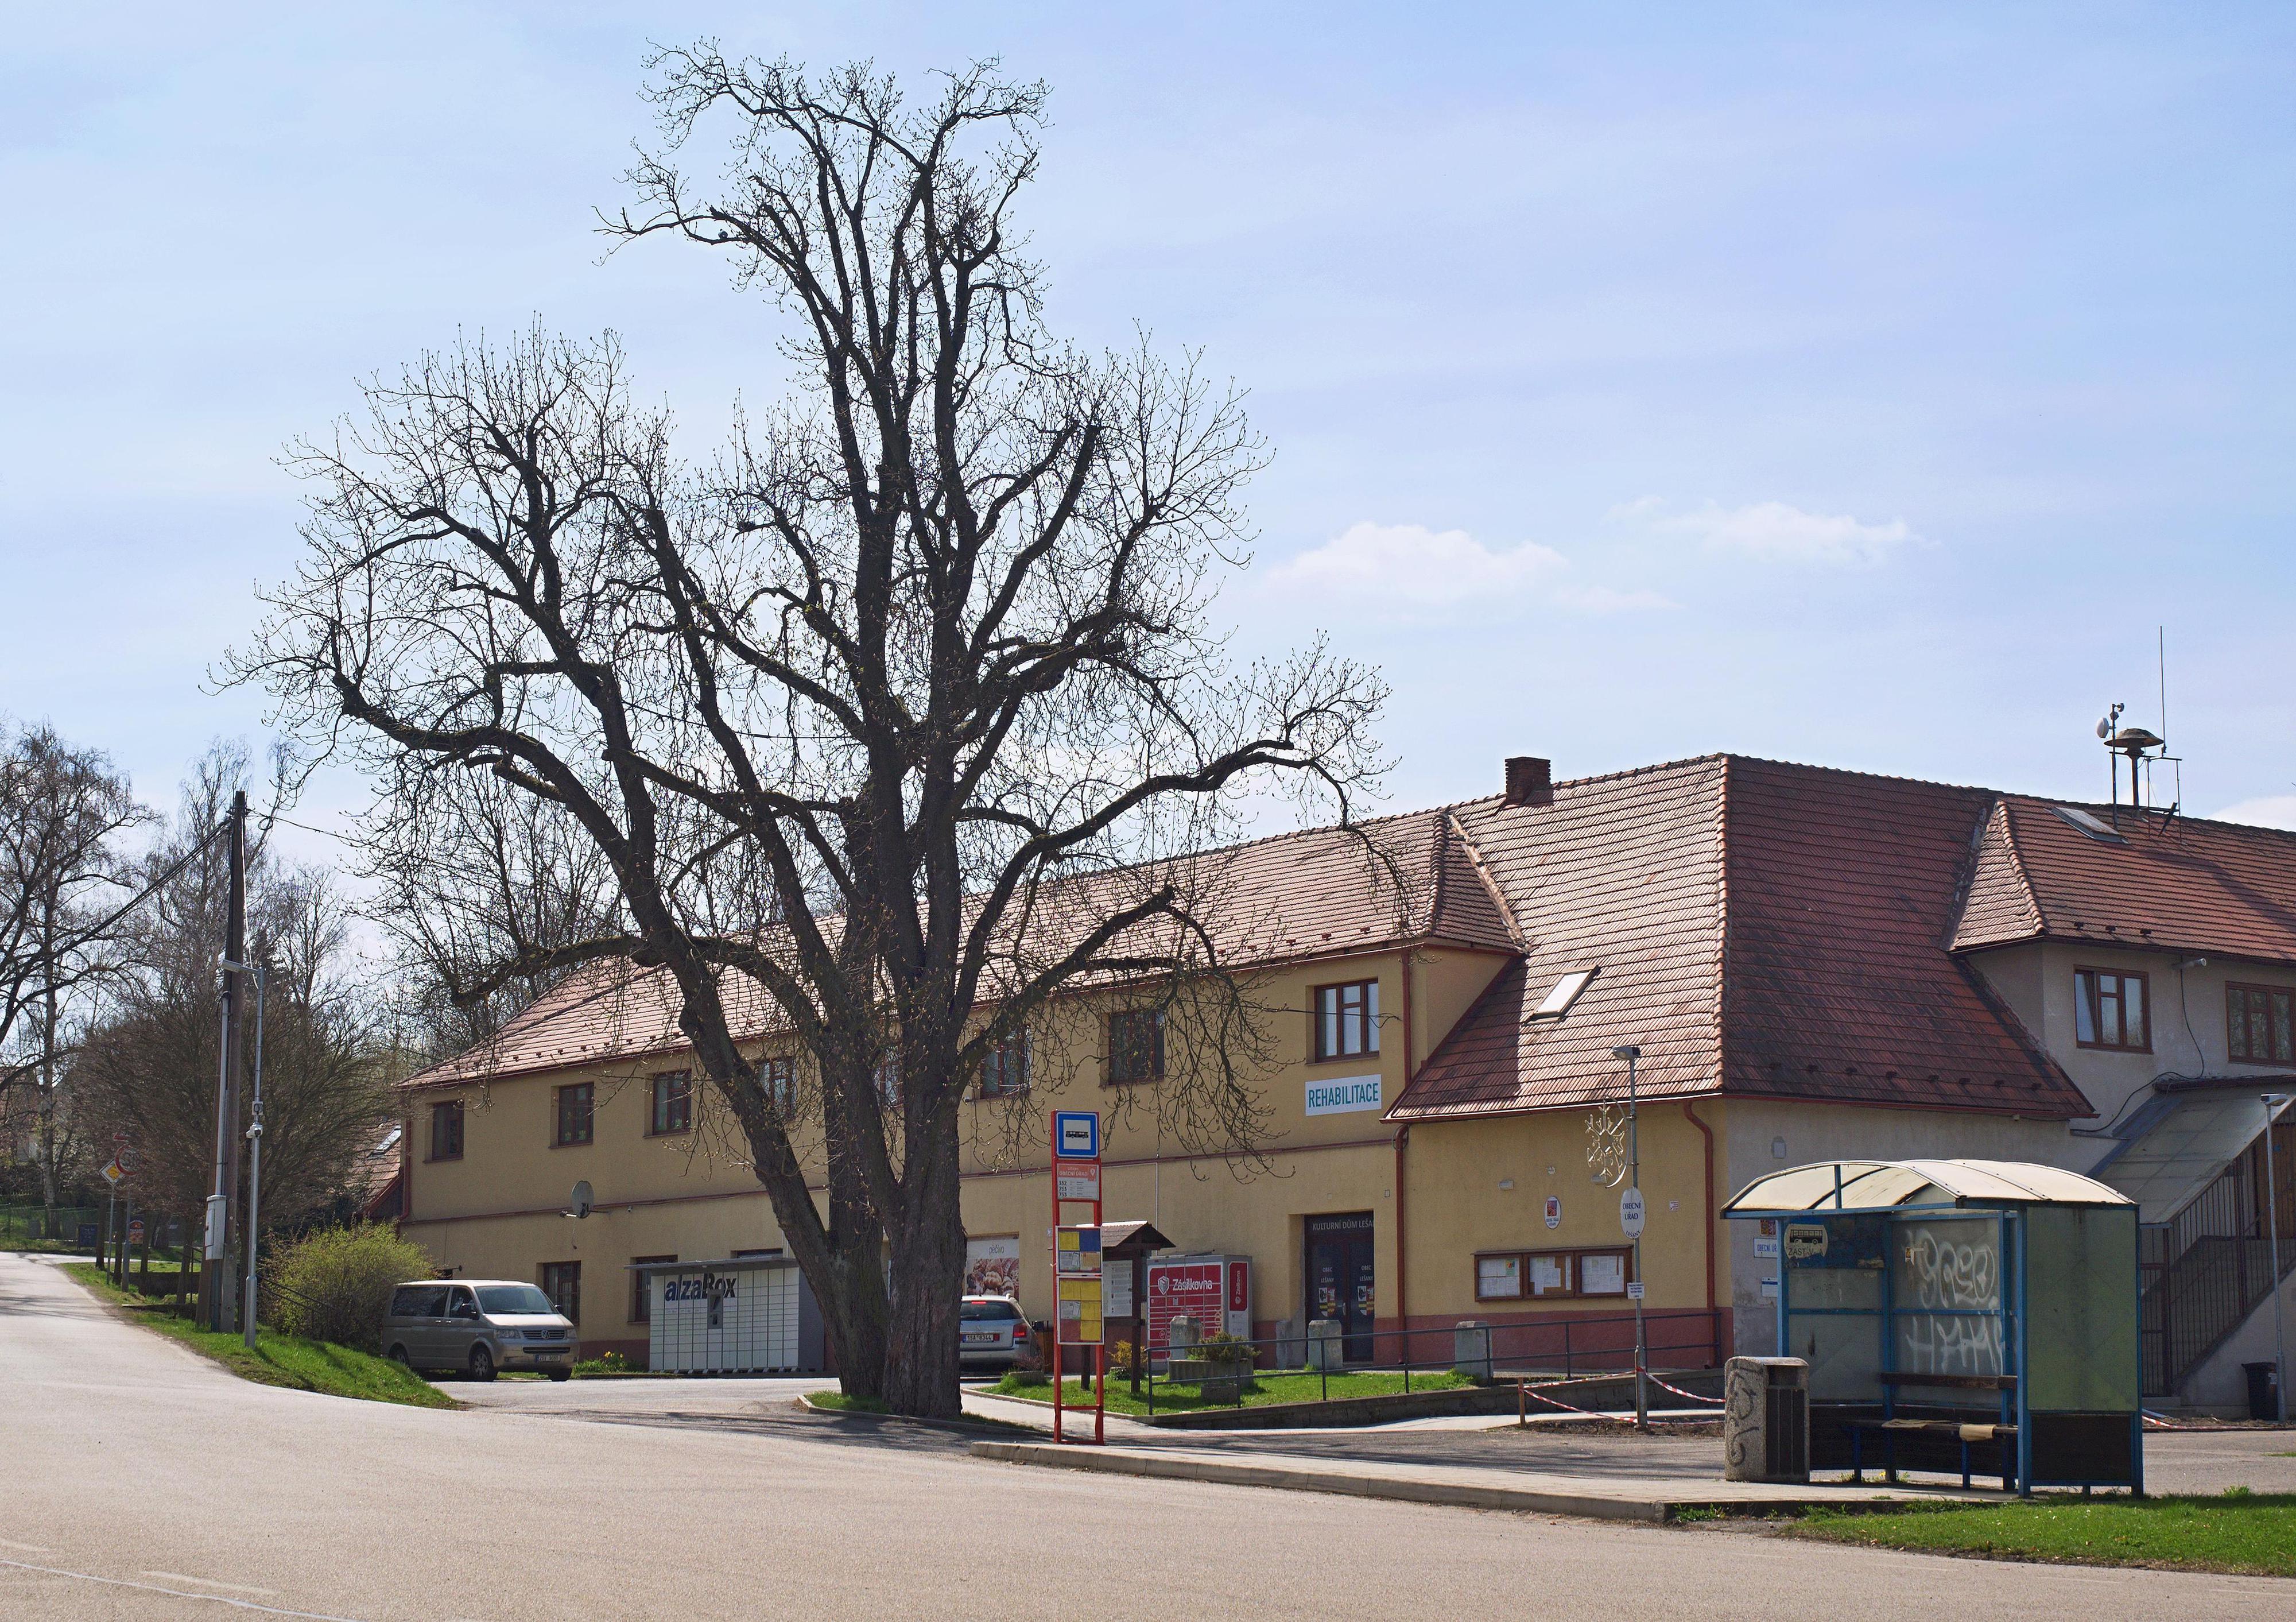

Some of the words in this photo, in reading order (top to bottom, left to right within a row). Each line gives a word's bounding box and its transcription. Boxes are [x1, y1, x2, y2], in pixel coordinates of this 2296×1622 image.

[1309, 1083, 1379, 1108] REHABILITACE
[1623, 1200, 1641, 1209] OBECNÍ
[1624, 1211, 1638, 1220] ÚŘAD
[1312, 1220, 1341, 1230] KULTURNÍ
[1343, 1220, 1358, 1229] DŮM
[1359, 1219, 1374, 1228] LEŠA
[665, 1273, 737, 1302] alzaBox
[1172, 1278, 1212, 1291] Zásilkovna
